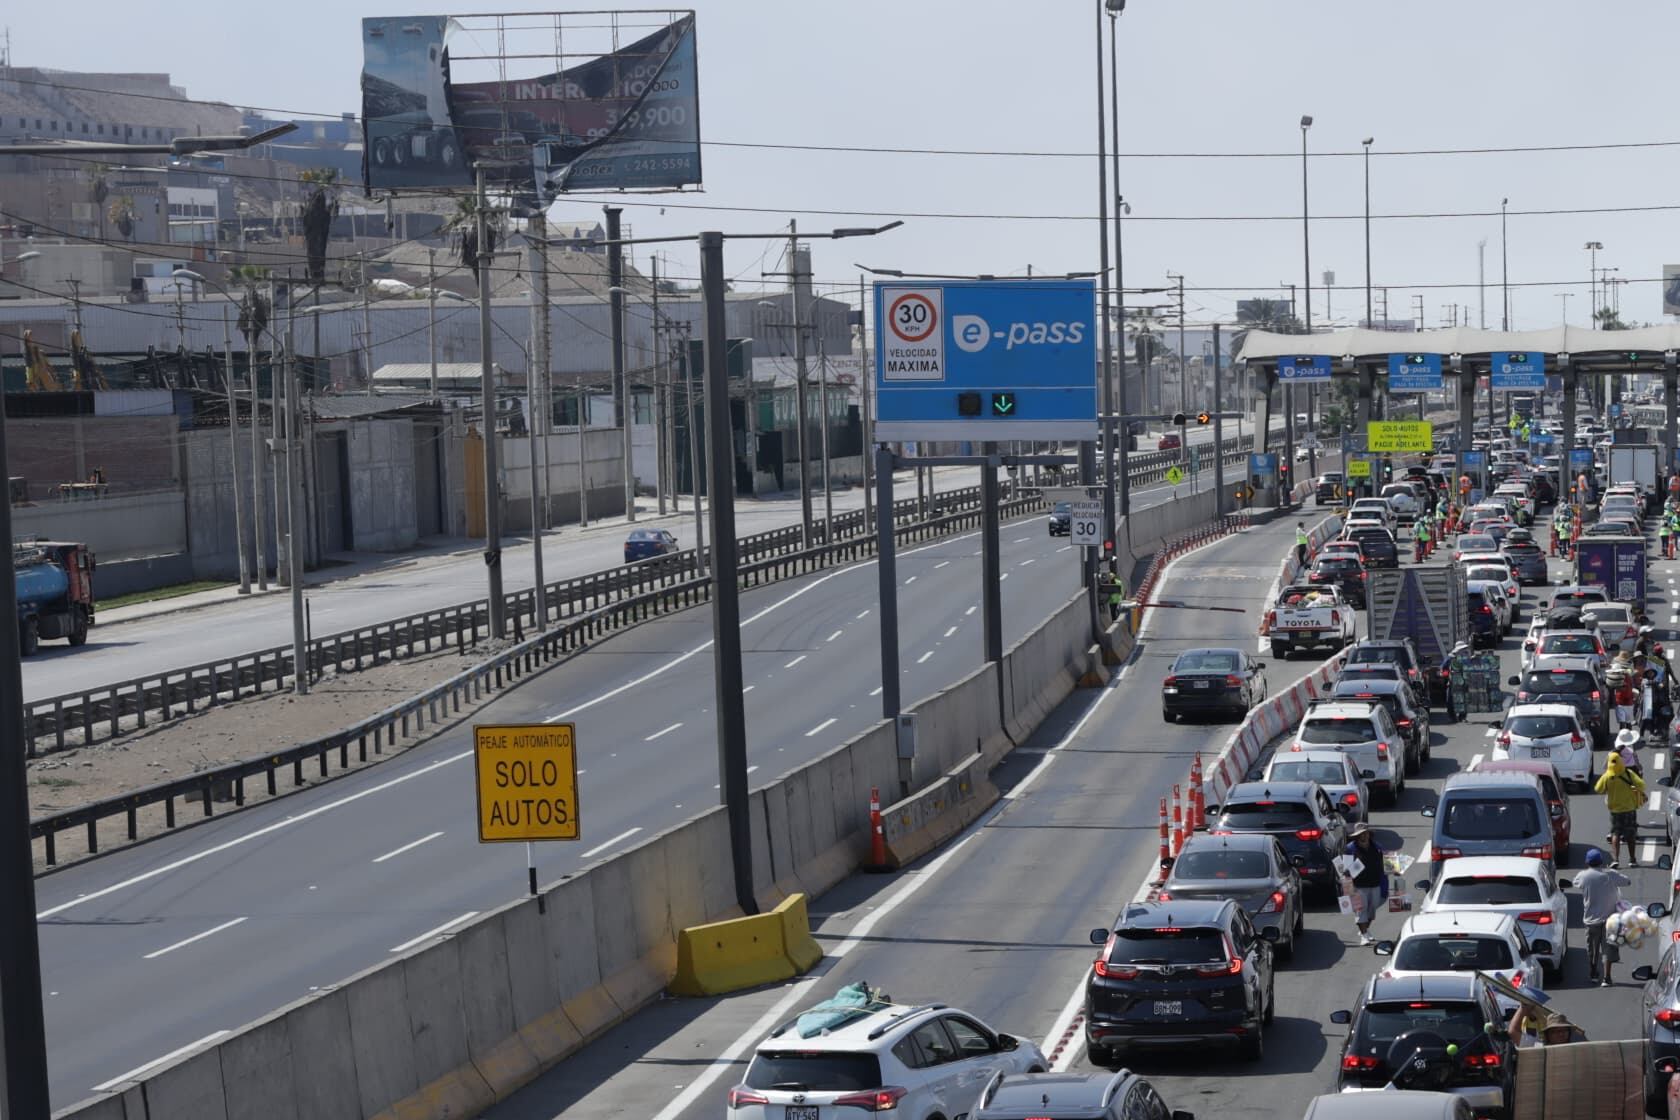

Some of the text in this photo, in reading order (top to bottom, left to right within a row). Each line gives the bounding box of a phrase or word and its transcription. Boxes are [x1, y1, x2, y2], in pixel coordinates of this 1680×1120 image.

[899, 303, 927, 323] 30
[958, 320, 1086, 351] e-pass
[889, 348, 938, 358] VELOCIDAD
[887, 360, 939, 373] MAXIMA
[1076, 521, 1096, 536] 30
[480, 735, 508, 749] PEAJE
[495, 759, 558, 788] SOLO
[489, 798, 568, 827] AUTOS
